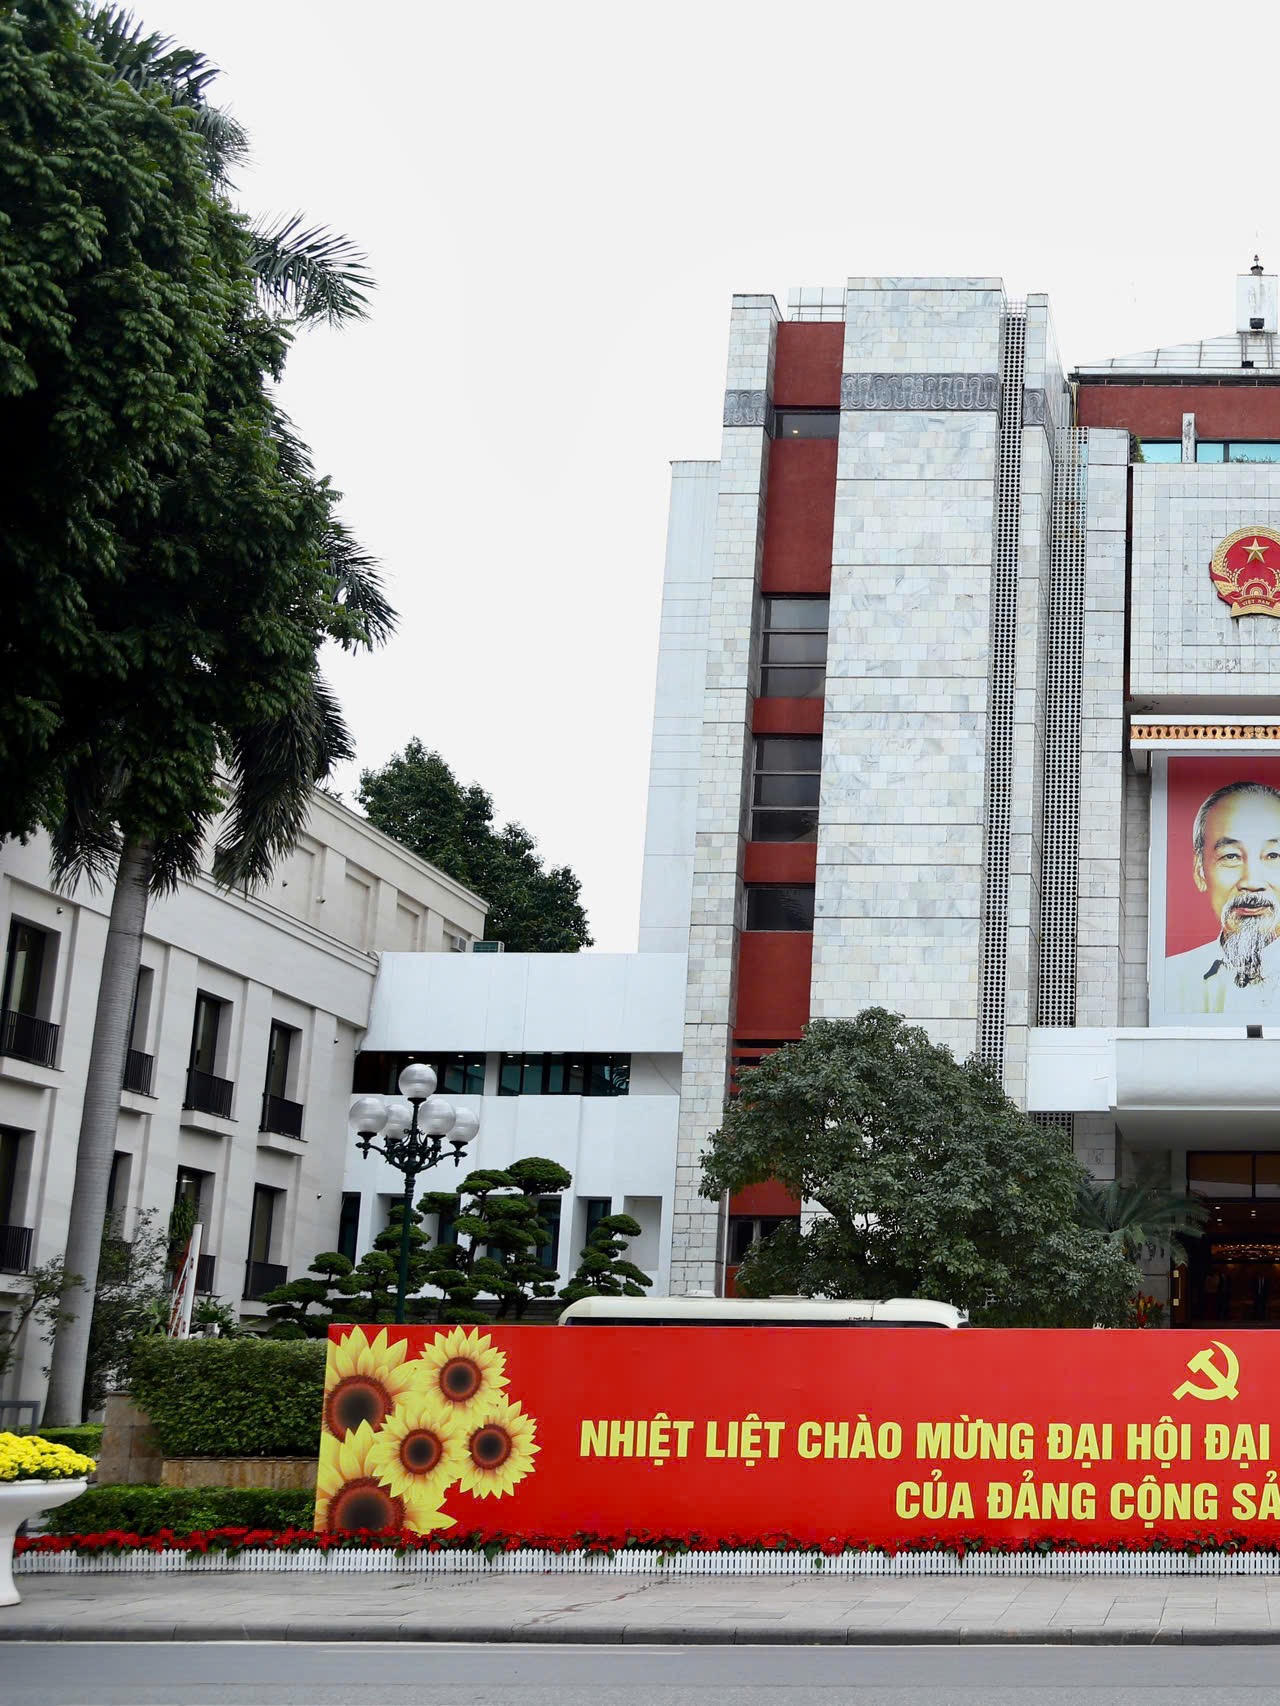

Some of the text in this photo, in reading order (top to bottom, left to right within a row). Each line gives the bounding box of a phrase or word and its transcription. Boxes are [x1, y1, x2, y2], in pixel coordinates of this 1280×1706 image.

[580, 1413, 694, 1466] NHIỆT
[705, 1414, 785, 1467] LIỆT
[797, 1414, 902, 1460] CHÀO
[916, 1415, 1034, 1460] MỪNG
[1046, 1423, 1113, 1468] ĐẠI
[1127, 1416, 1191, 1469] HỘI
[1203, 1423, 1270, 1469] ĐẠI
[895, 1469, 975, 1519] CỦA
[986, 1469, 1096, 1520] ĐẢNG
[1110, 1475, 1218, 1529] CỘNG
